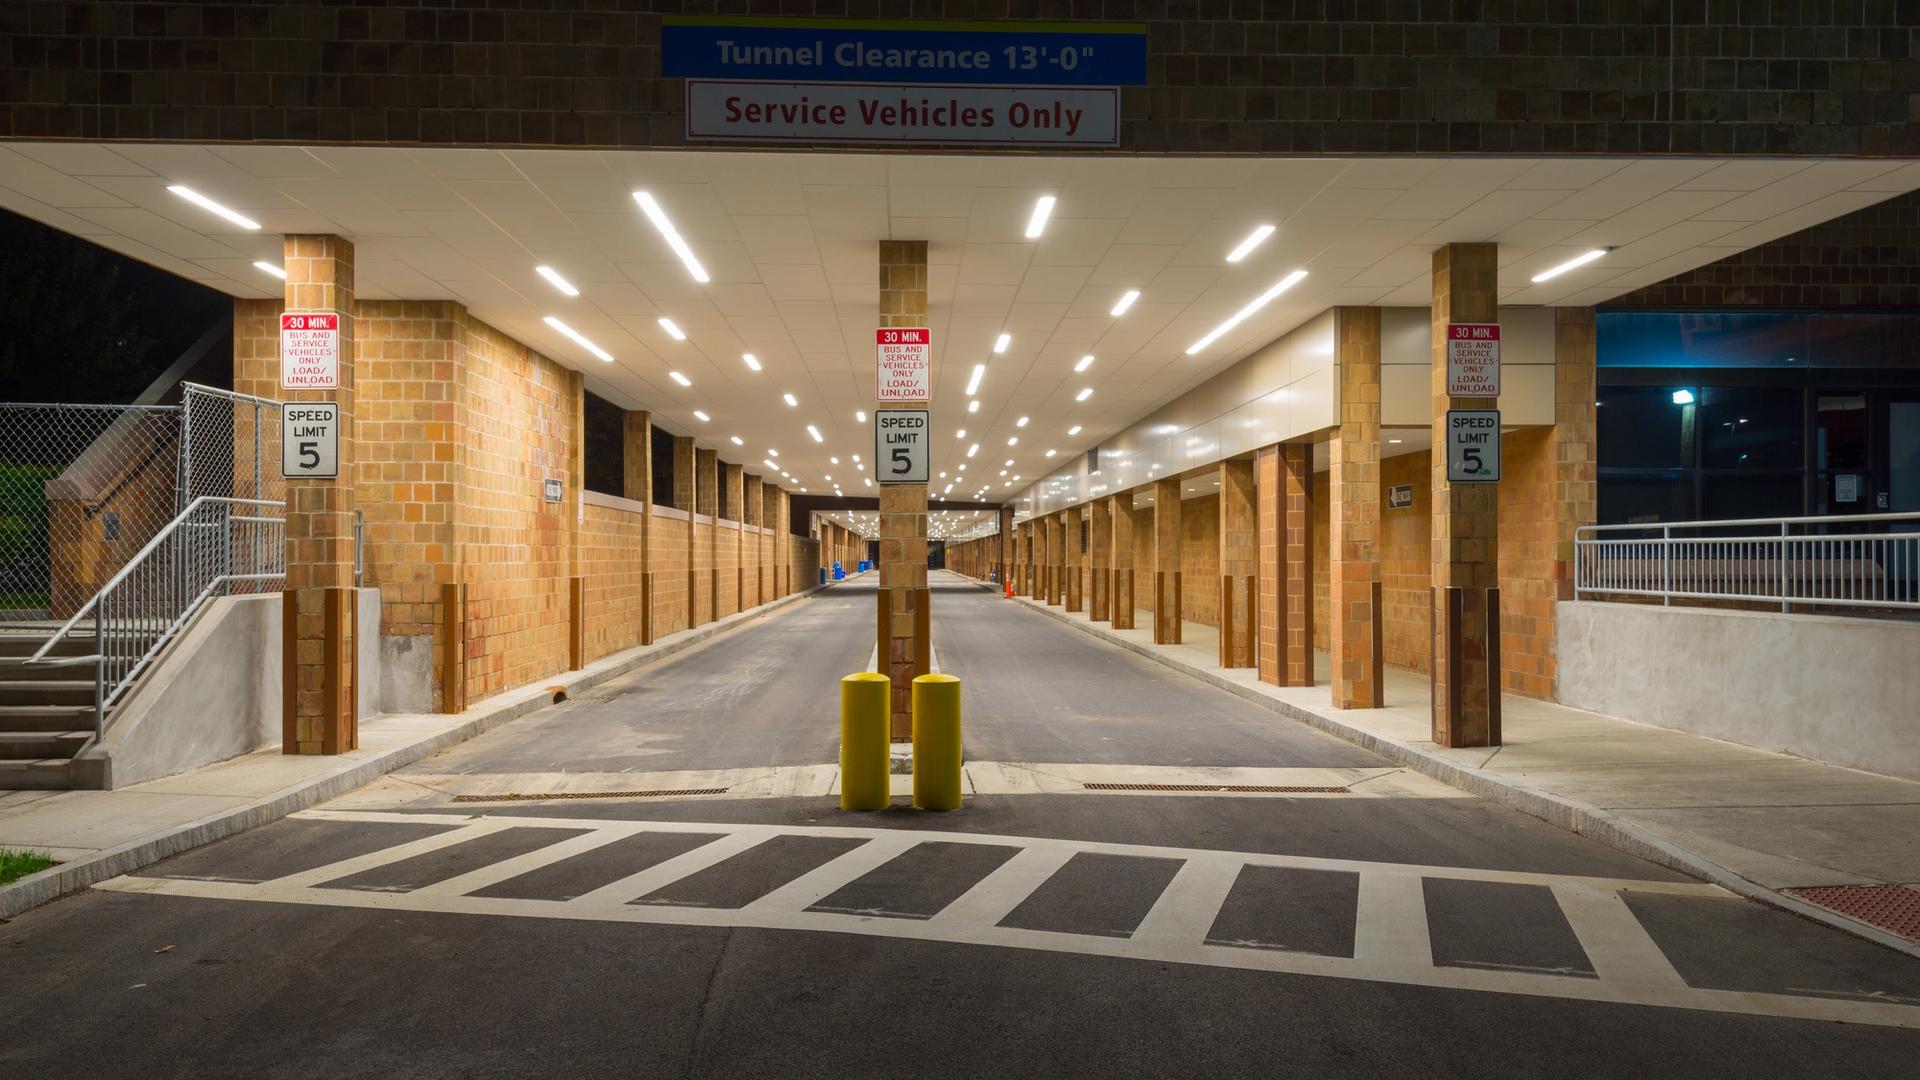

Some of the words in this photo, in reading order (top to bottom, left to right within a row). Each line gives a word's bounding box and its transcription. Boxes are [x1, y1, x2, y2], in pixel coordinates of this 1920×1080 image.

[717, 40, 822, 66] Tunnel
[834, 42, 990, 69] Clearance
[1003, 46, 1094, 70] 13'-0"
[725, 97, 846, 124] Service
[859, 100, 994, 128] Vehicles
[1008, 102, 1082, 136] Only
[290, 318, 304, 328] 30
[309, 318, 329, 328] MIN.
[885, 332, 897, 342] 30
[902, 332, 922, 342] MIN.
[1456, 328, 1468, 338] 30
[1473, 328, 1492, 338] MIN.
[288, 411, 332, 421] SPEED
[881, 418, 923, 428] SPEED
[1453, 418, 1494, 428] SPEED
[294, 427, 327, 437] LIMIT
[887, 434, 918, 443] LIMIT
[1458, 434, 1489, 443] LIMIT
[299, 442, 320, 468] 5
[892, 449, 912, 474] 5
[1463, 448, 1482, 473] 5
